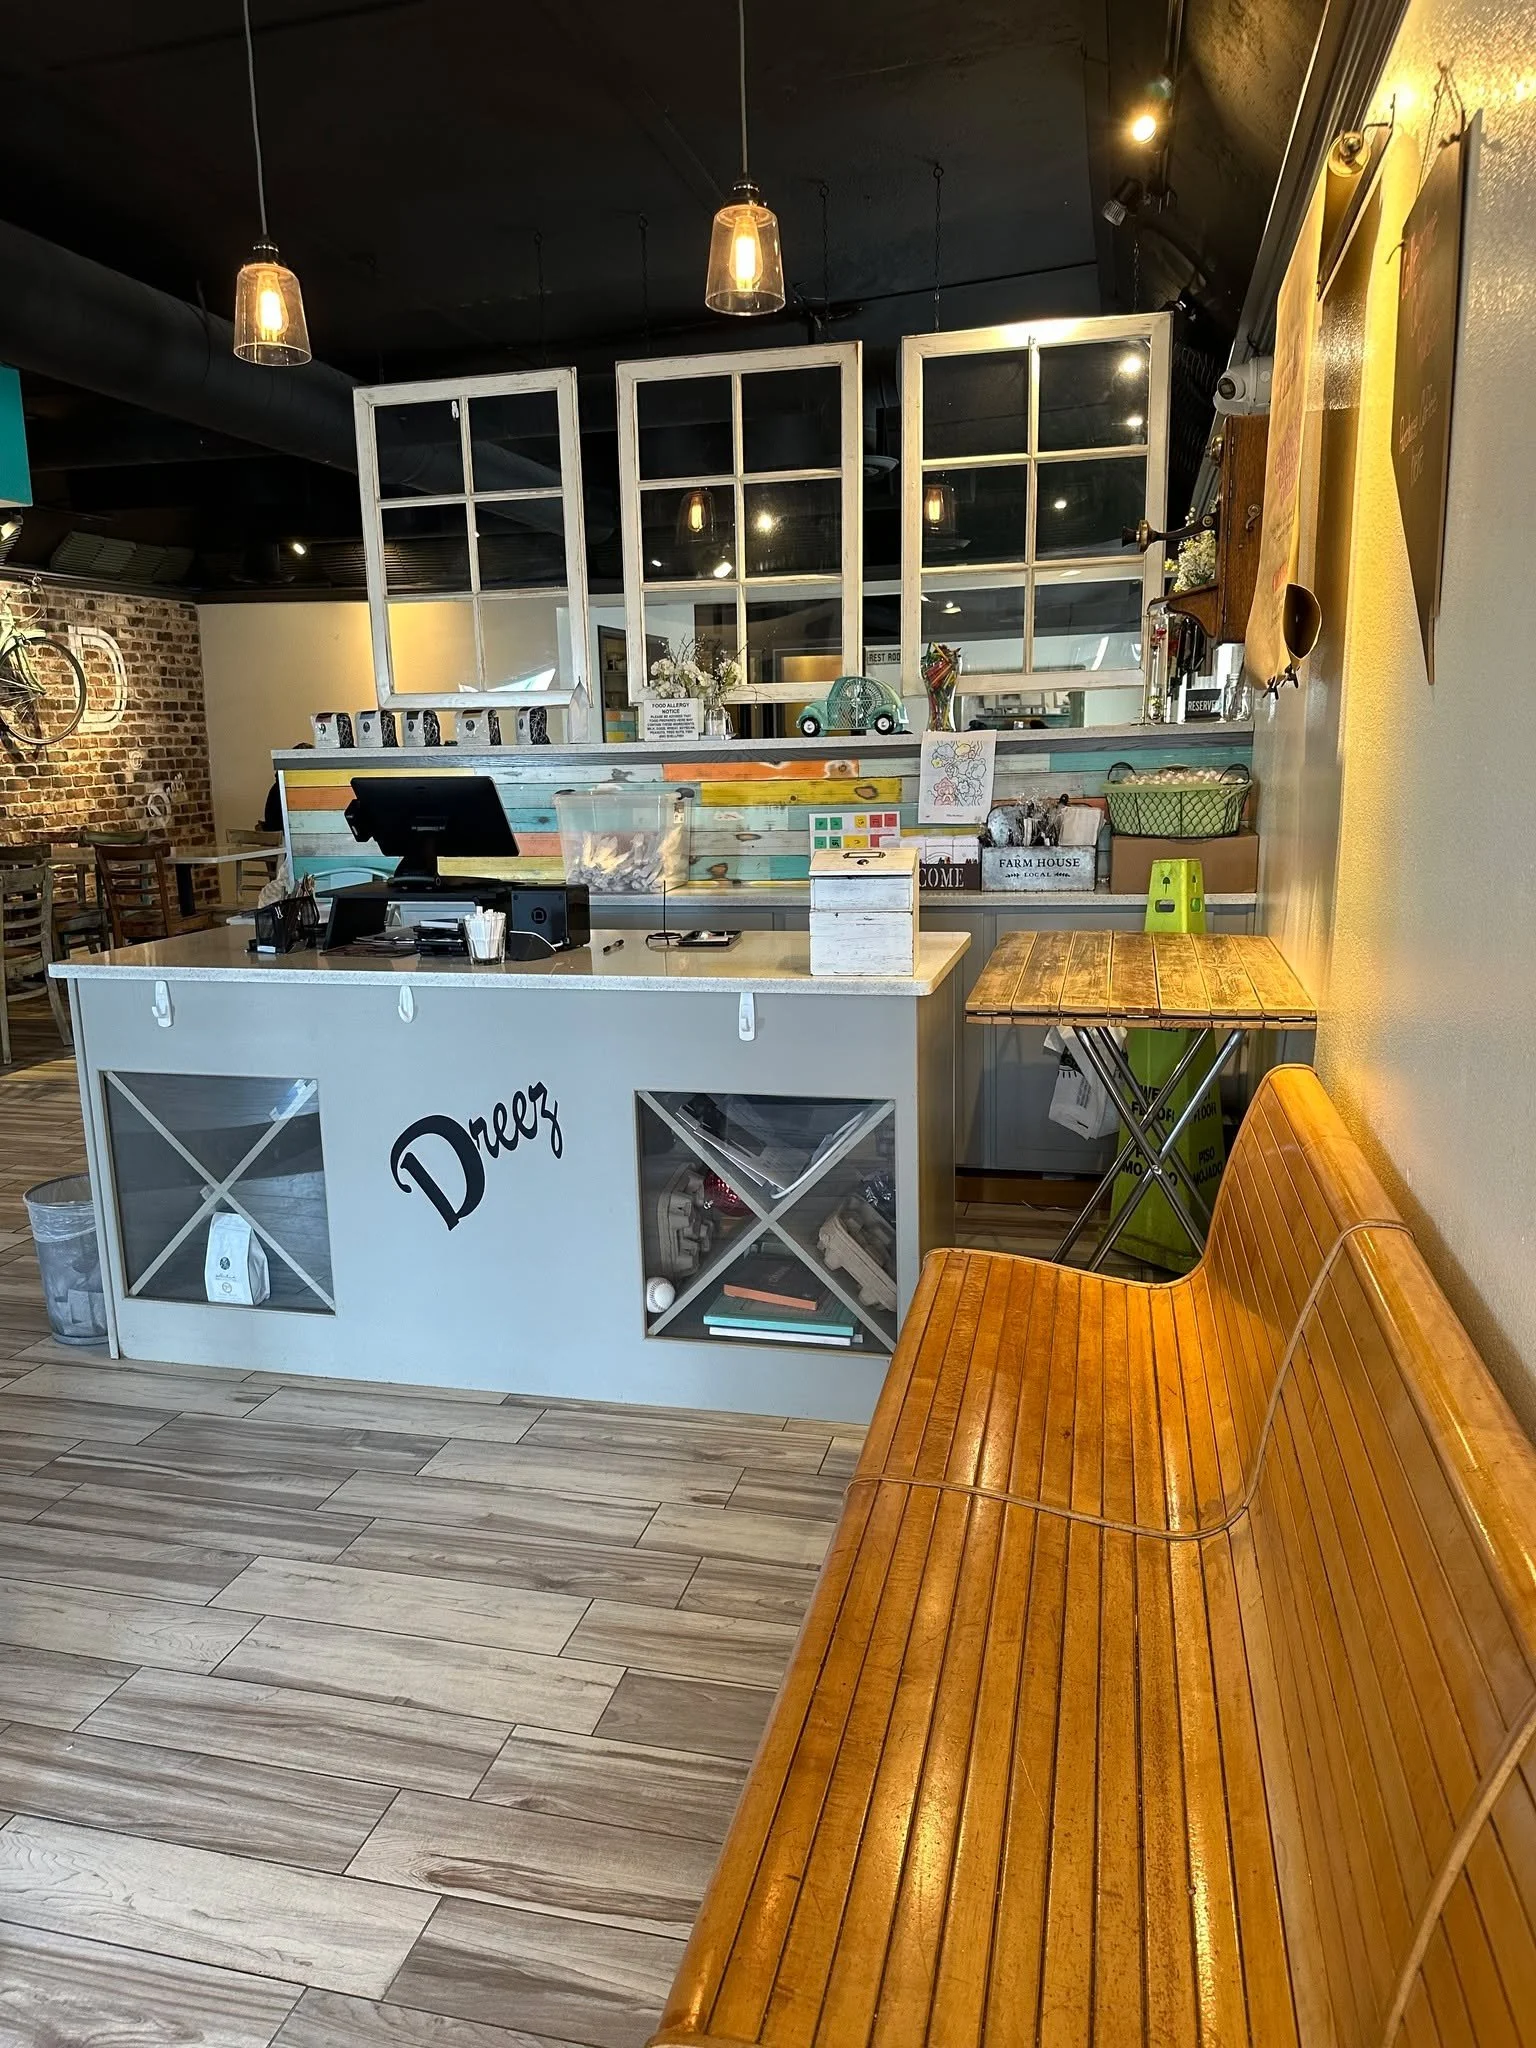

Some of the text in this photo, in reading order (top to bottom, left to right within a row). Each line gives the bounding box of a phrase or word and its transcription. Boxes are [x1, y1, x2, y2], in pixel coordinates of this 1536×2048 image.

[869, 652, 901, 662] REST ROO
[1187, 700, 1220, 711] RESERVE
[999, 858, 1080, 868] FARM HOUSE
[919, 868, 964, 888] COME
[1139, 1085, 1161, 1101] WE
[1131, 1101, 1175, 1123] FLOR
[390, 1081, 563, 1231] Dreez
